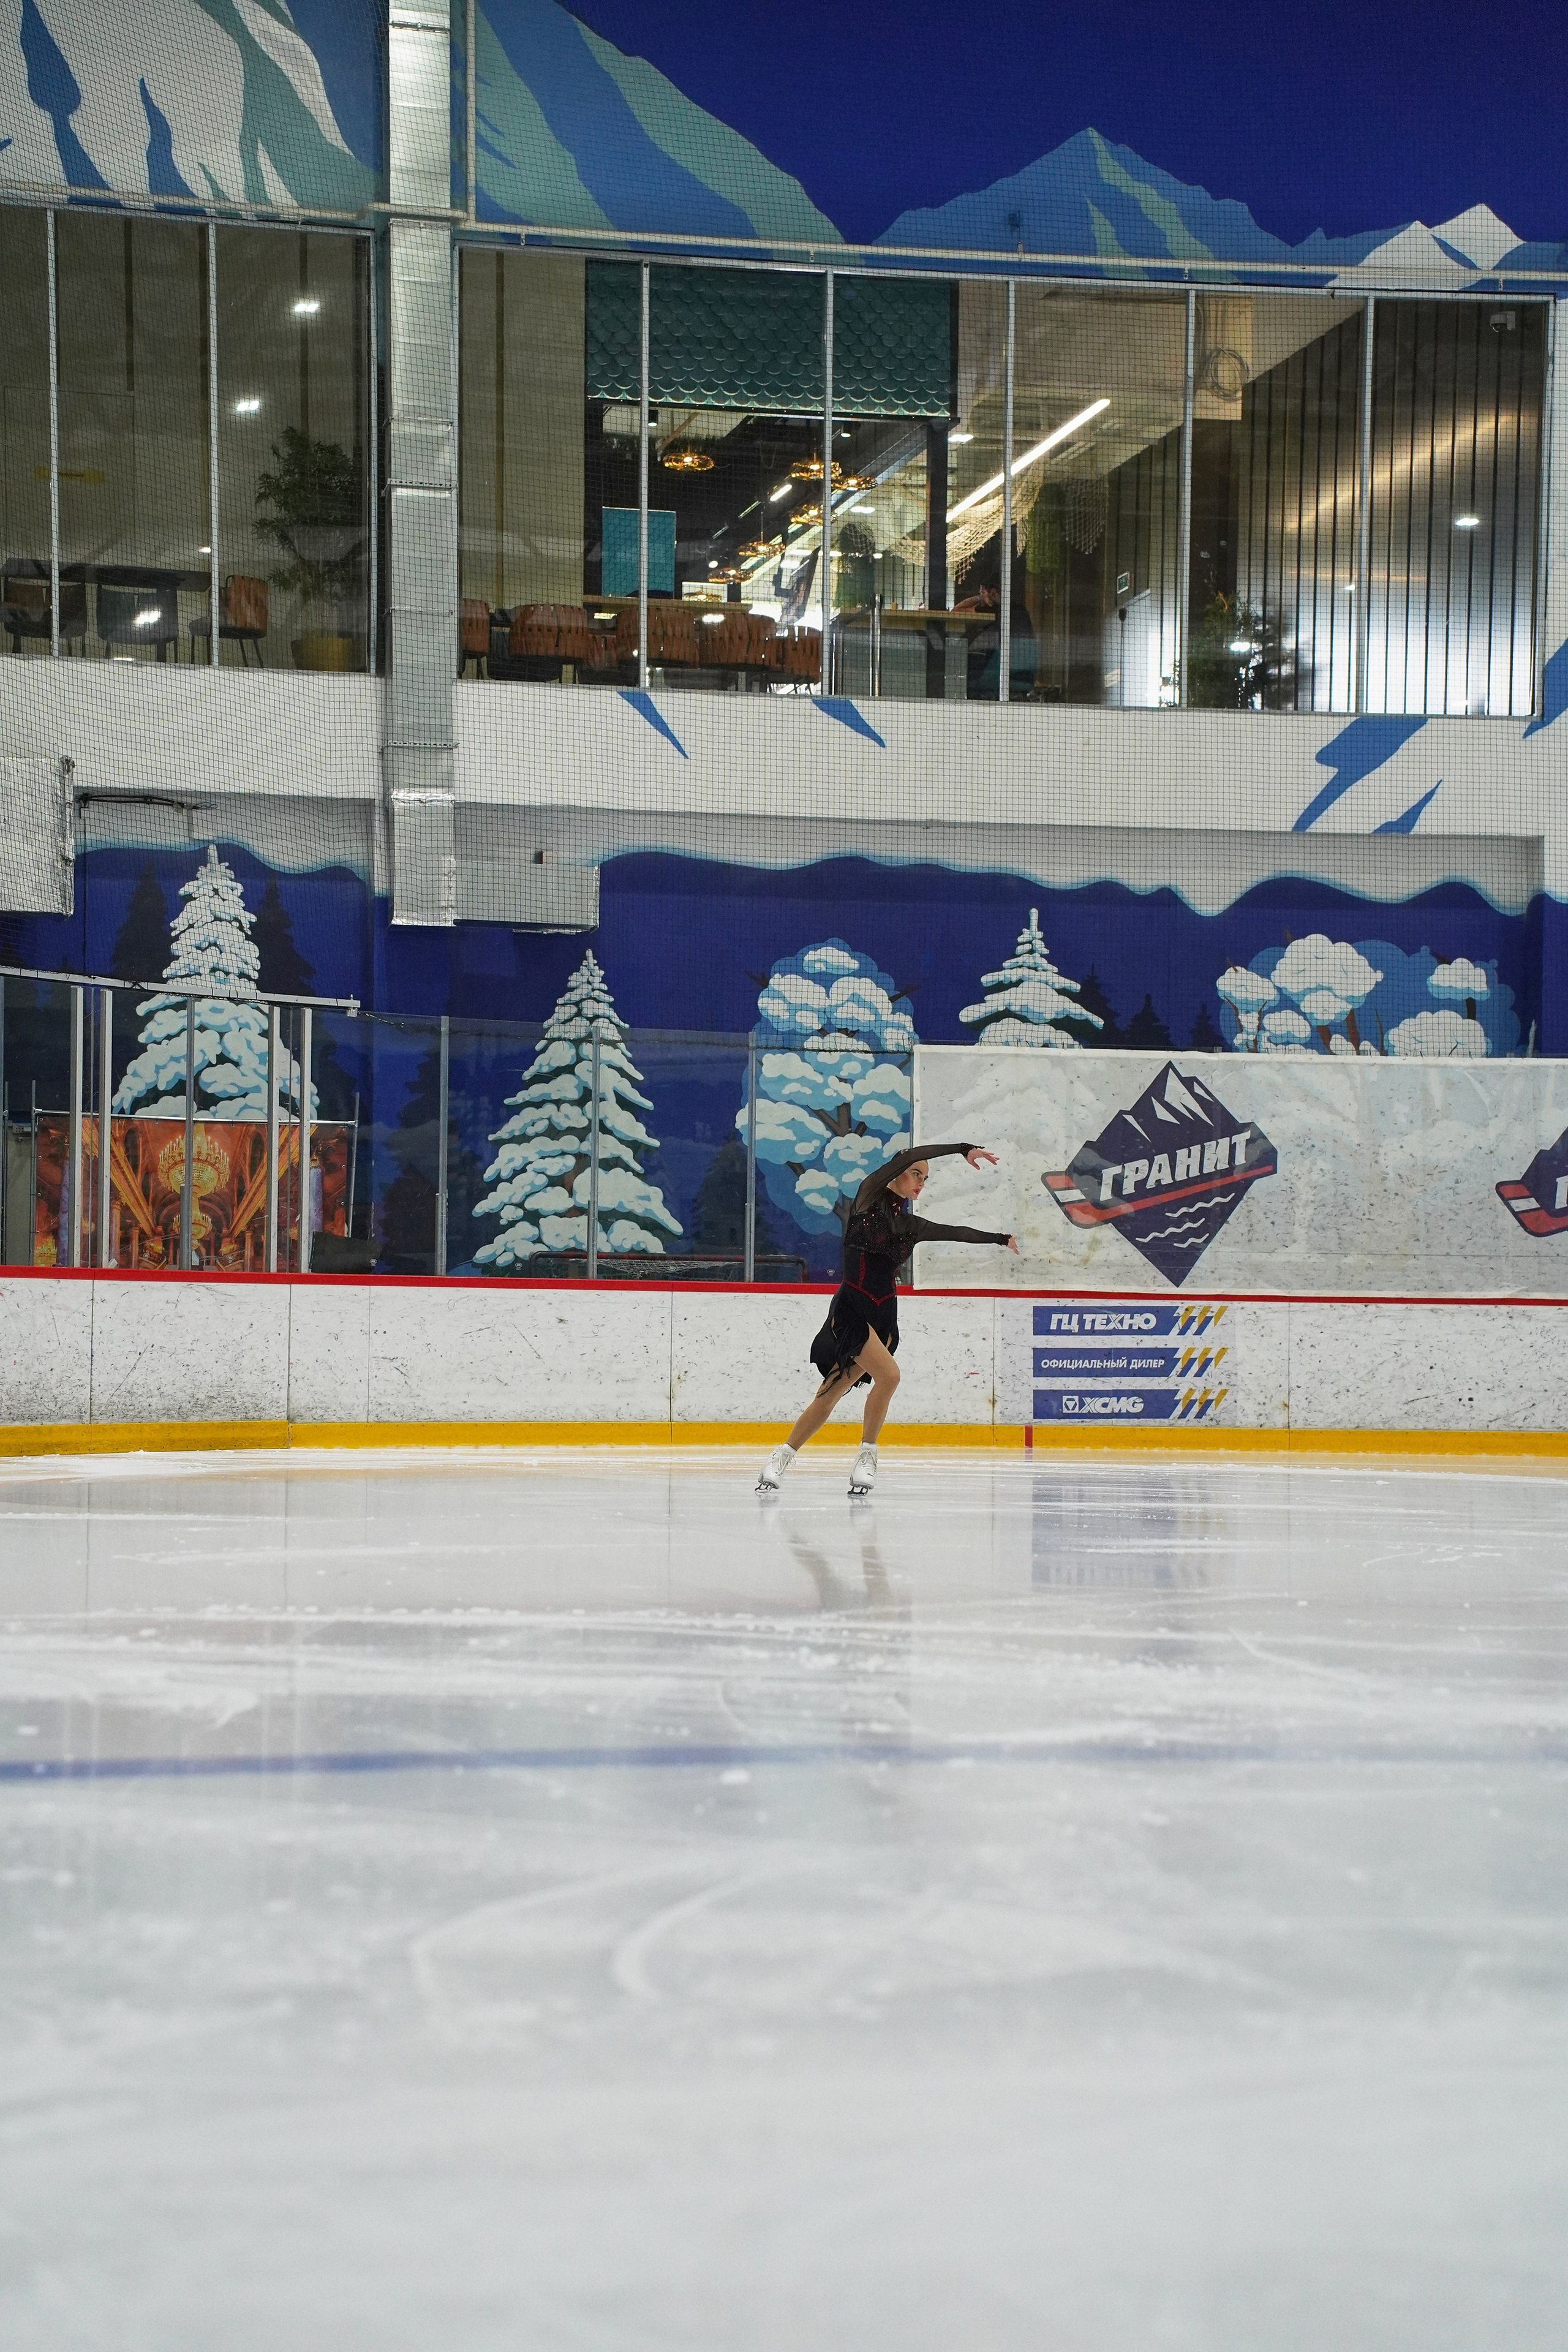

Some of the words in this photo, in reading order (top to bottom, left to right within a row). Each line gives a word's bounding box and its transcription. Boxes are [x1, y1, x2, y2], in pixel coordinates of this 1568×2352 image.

[1100, 1130, 1251, 1201] ГРАНИТ
[1050, 1313, 1079, 1333] ГЦ
[1083, 1313, 1157, 1330] ТЕХНО
[1041, 1357, 1128, 1370] ОФИЦИАЛЬНЫЙ
[1129, 1359, 1165, 1369] ДИЛЕР
[1079, 1396, 1144, 1413] XCMG
